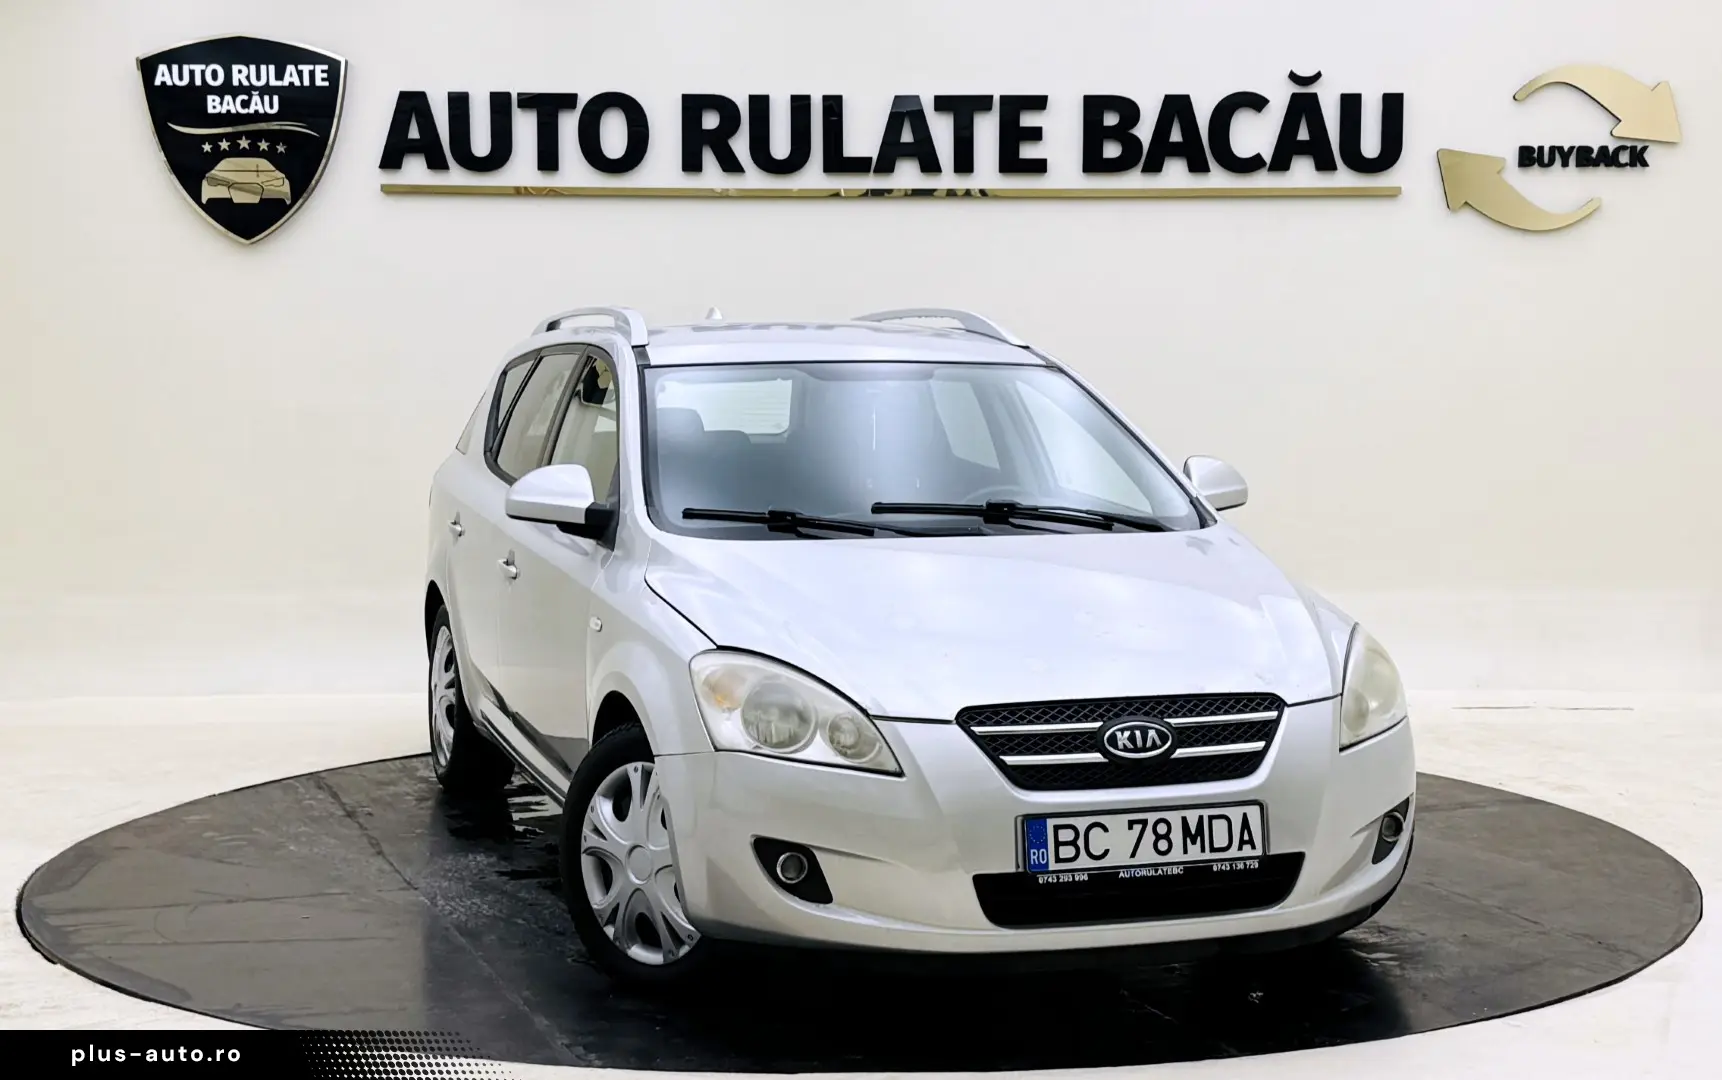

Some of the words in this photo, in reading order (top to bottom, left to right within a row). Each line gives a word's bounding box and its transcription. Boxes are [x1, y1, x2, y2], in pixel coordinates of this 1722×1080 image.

[154, 64, 224, 87] AUTO
[231, 64, 330, 87] RULATE
[206, 91, 279, 115] BACĂU
[379, 91, 650, 175] AUTO
[681, 93, 1049, 176] RULATE
[1082, 70, 1405, 175] BACĂU
[1517, 144, 1650, 169] BUYBACK
[1114, 728, 1163, 750] KIA
[1052, 821, 1110, 864] BC
[1127, 817, 1173, 859] 78
[1181, 812, 1257, 855] MDA
[1030, 848, 1048, 865] RO
[1118, 866, 1184, 879] AUTORULATEBC
